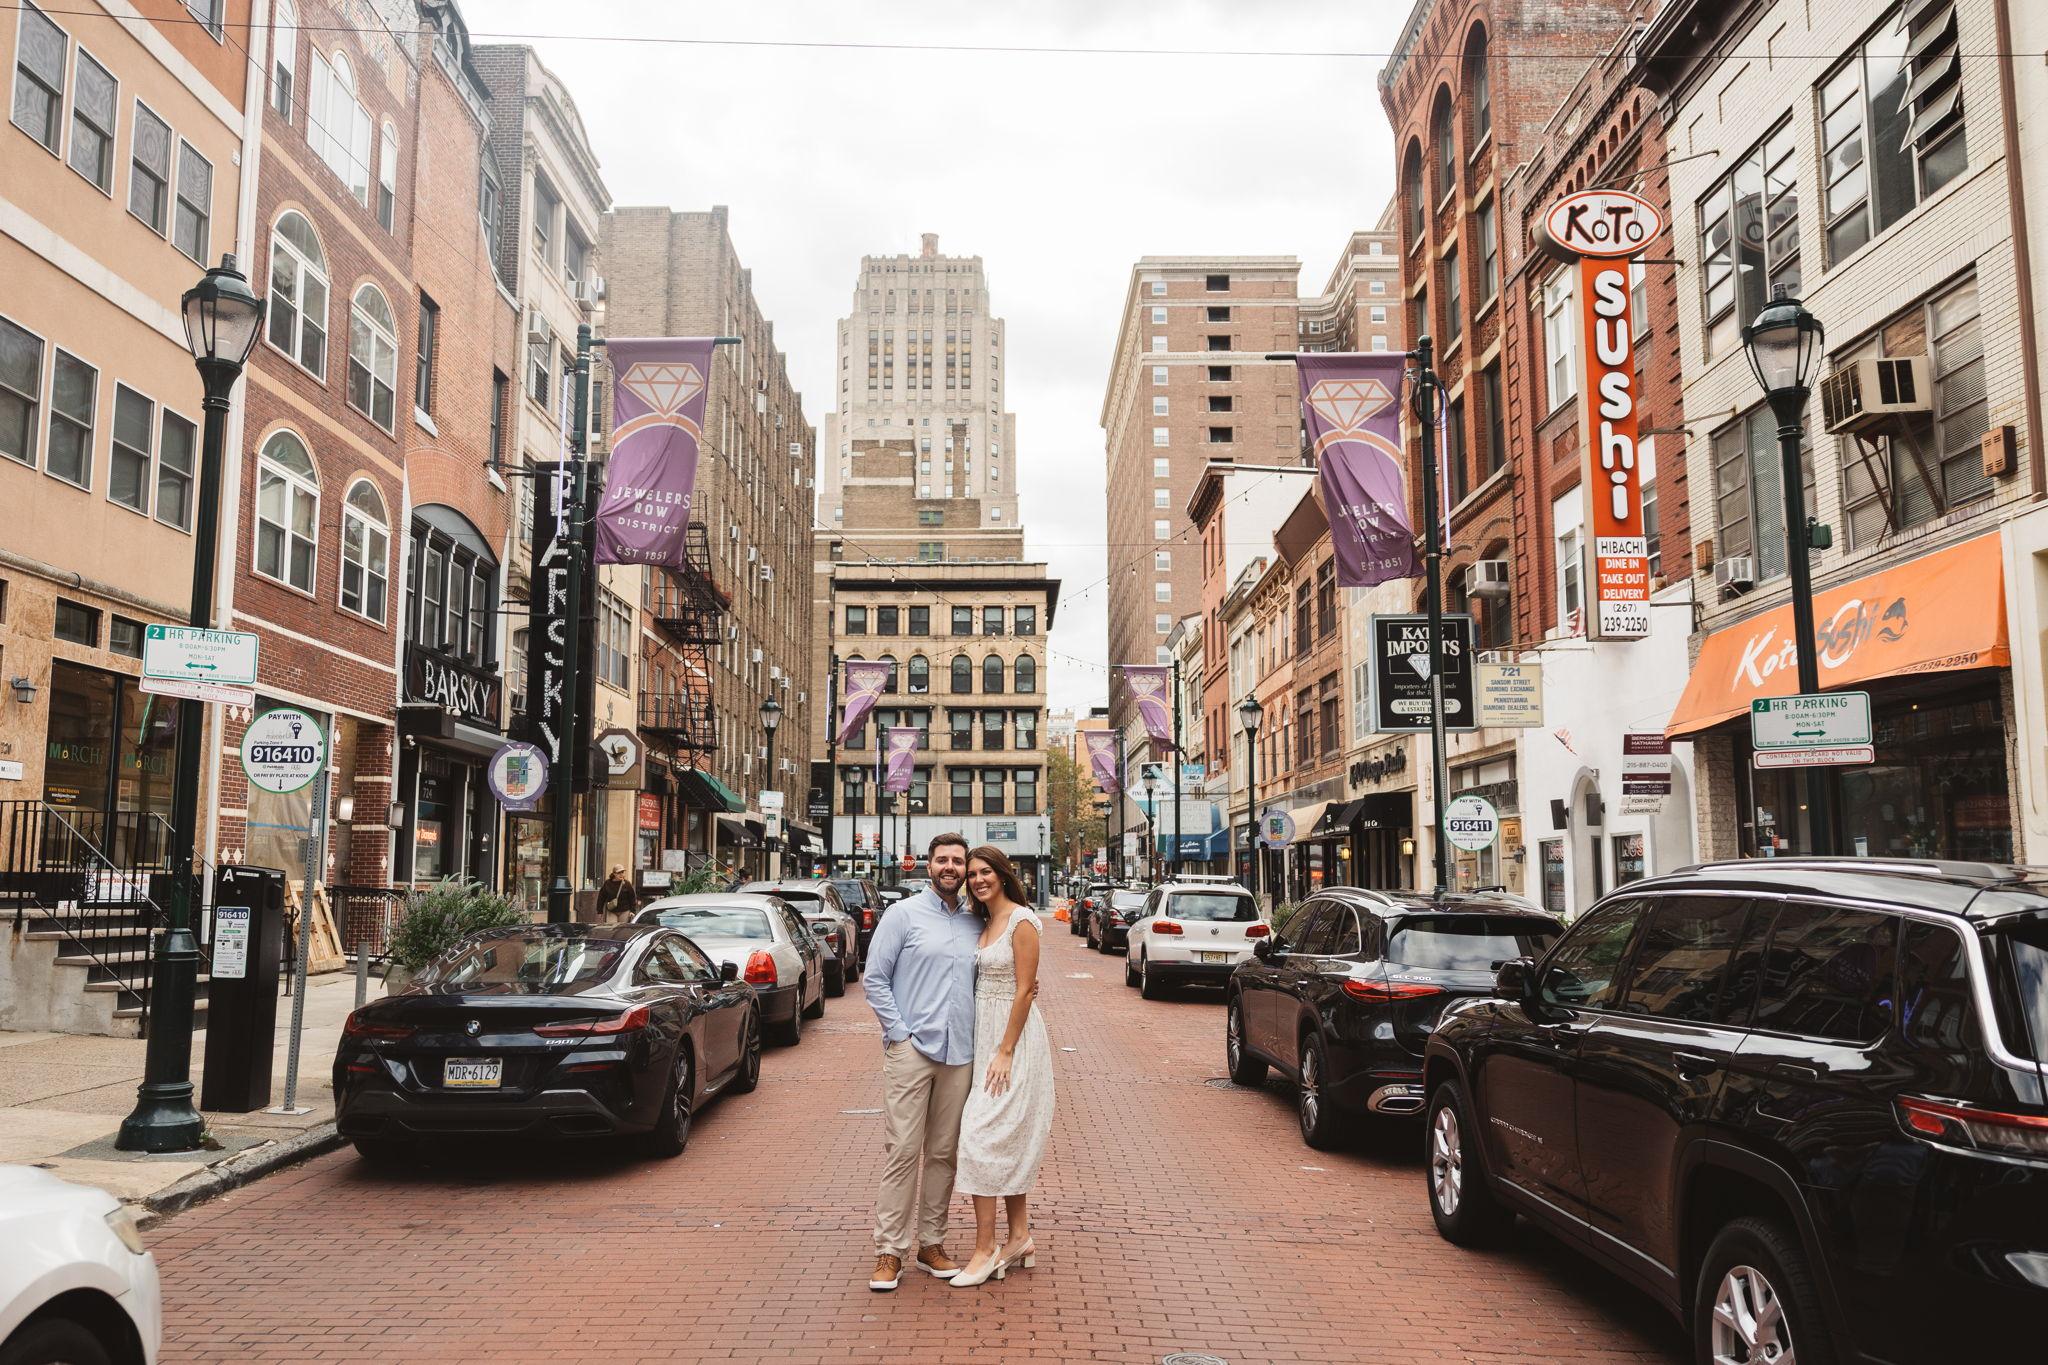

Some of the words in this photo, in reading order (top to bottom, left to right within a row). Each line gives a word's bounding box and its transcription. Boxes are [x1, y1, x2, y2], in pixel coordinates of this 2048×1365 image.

[612, 486, 691, 510] JEWELERS
[634, 502, 668, 518] ROW
[618, 516, 679, 534] DISTRICT
[616, 544, 639, 558] EST
[645, 551, 667, 560] 1851
[1601, 541, 1643, 554] HIBACHI
[1380, 557, 1402, 569] 1851
[1606, 559, 1627, 569] DINE
[1629, 559, 1639, 568] IN
[1601, 574, 1623, 584] TAKE
[1626, 574, 1645, 584] OUT
[1604, 589, 1645, 599] DELIVERY
[1613, 603, 1637, 613] (267)
[1604, 617, 1648, 632] 239-2250
[152, 627, 160, 638] 2
[169, 629, 184, 640] HR
[191, 630, 241, 645] PARKING
[1500, 667, 1521, 677] 721
[424, 659, 491, 718] BARSKY
[1758, 701, 1765, 711] 2
[1772, 700, 1788, 711] HR
[1795, 697, 1848, 709] PARKING
[253, 747, 312, 762] 916410
[1452, 820, 1490, 831] 916411
[222, 868, 234, 882] A
[218, 911, 248, 920] 916410
